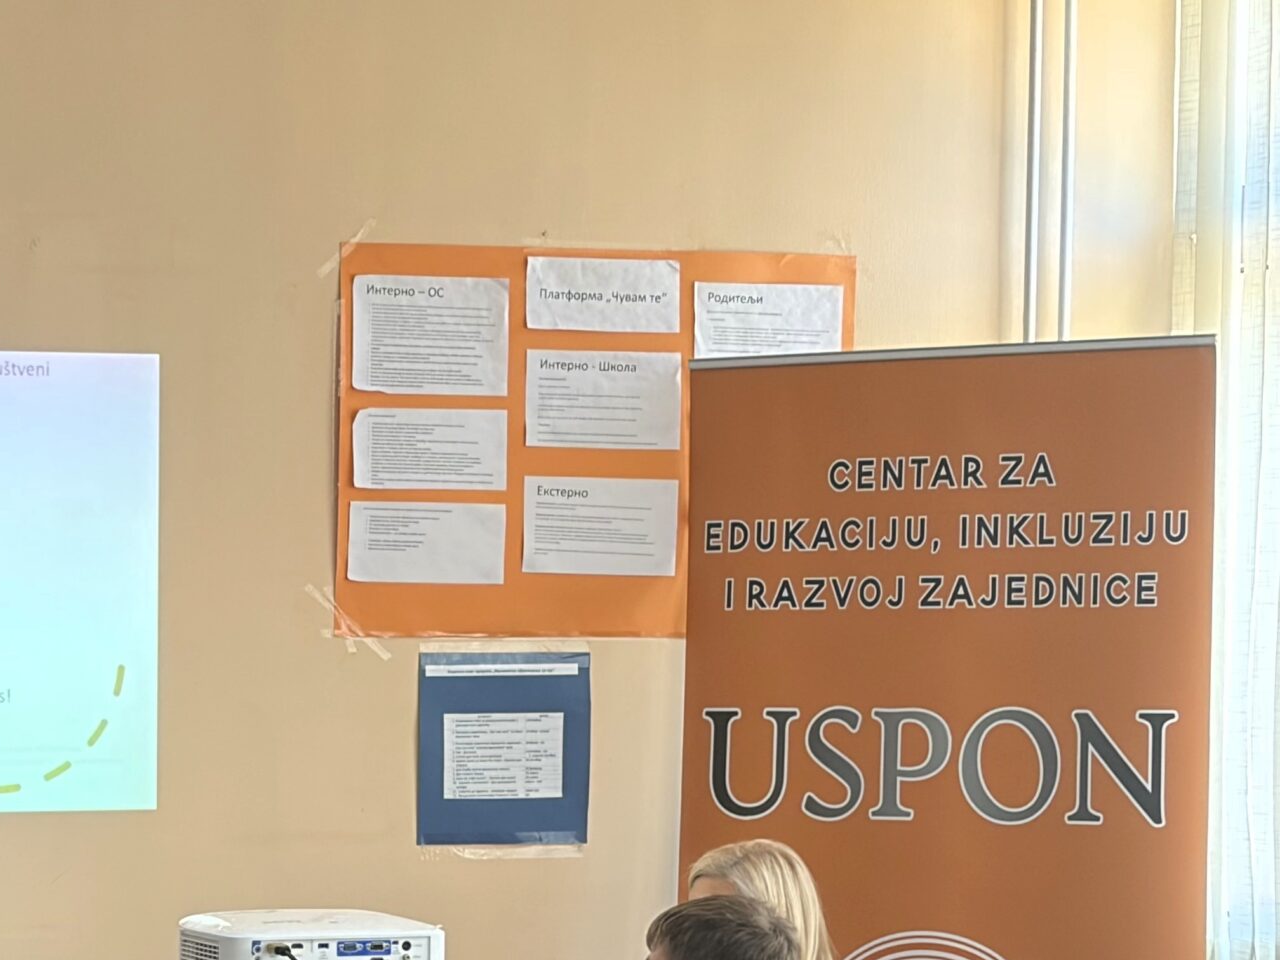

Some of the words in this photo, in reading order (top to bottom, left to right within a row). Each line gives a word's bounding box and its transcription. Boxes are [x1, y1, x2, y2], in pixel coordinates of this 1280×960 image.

[366, 284, 415, 297] Интерно
[428, 287, 444, 298] ОС
[539, 288, 603, 302] Платформа
[708, 292, 763, 305] Родитељи
[540, 360, 589, 371] Интерно
[599, 361, 637, 373] Школа
[827, 455, 988, 493] CENTAR
[999, 452, 1056, 488] ZA
[537, 485, 589, 499] Екстерно
[703, 514, 942, 553] EDUKACIJU,
[959, 509, 1189, 549] INKLUZIJU
[724, 577, 734, 611] I
[745, 575, 905, 610] RAZVOJ
[917, 571, 1159, 609] ZAJEDNICE
[702, 704, 1179, 828] USPON
